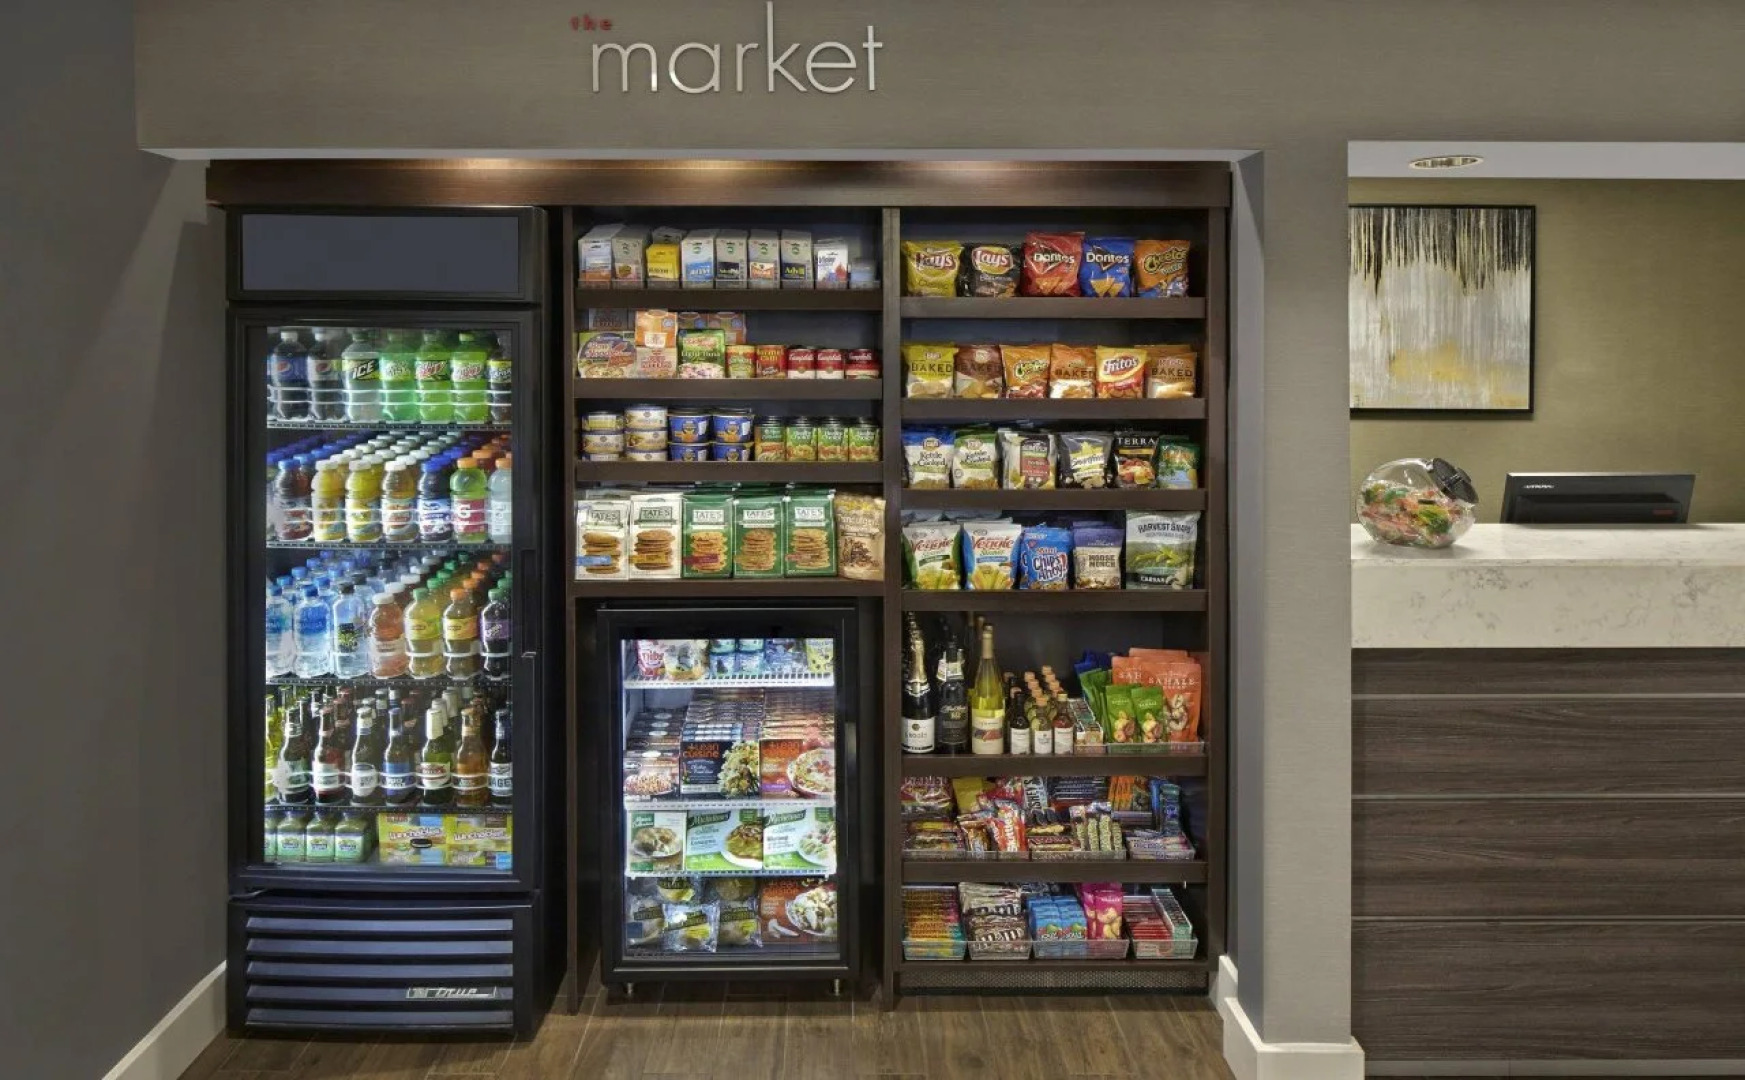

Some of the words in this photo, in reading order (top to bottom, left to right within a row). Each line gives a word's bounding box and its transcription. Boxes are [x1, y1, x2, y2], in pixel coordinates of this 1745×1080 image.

[570, 14, 612, 31] the
[592, 1, 883, 94] market
[1034, 252, 1076, 264] Doritos
[1085, 251, 1130, 264] Doritos
[352, 361, 374, 379] ICE
[911, 362, 952, 373] BAKED
[1102, 357, 1139, 373] Fritos
[1151, 368, 1193, 377] BAKED
[1117, 437, 1155, 446] TERRA
